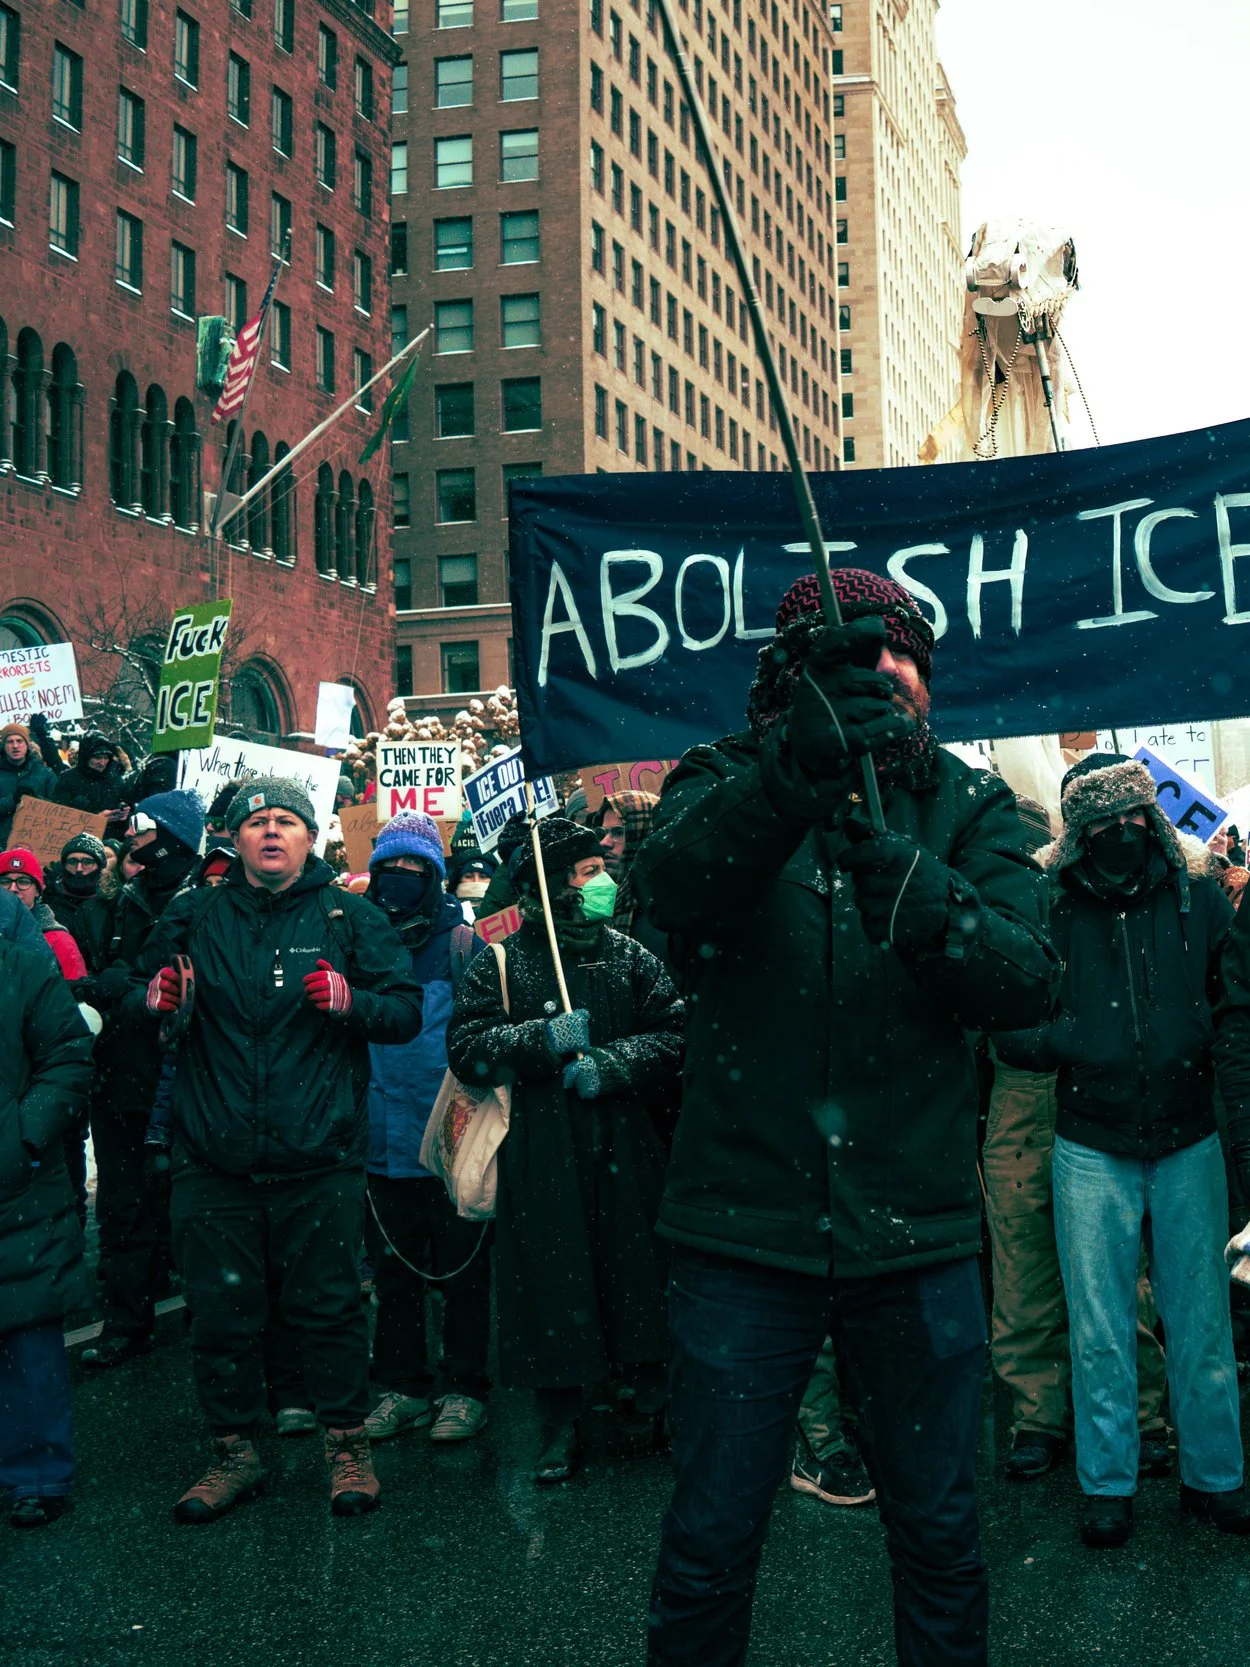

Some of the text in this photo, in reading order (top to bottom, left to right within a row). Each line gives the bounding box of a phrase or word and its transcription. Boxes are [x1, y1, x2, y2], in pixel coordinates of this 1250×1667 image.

[537, 529, 1027, 688] ABOLSH
[0, 660, 52, 679] RORISTS
[37, 684, 77, 709] NOEM
[1186, 725, 1206, 743] to
[199, 746, 231, 779] When
[381, 746, 456, 765] THEN THEY
[379, 767, 456, 787] CAME FOR
[476, 771, 498, 804] ICE
[391, 787, 445, 818] ME
